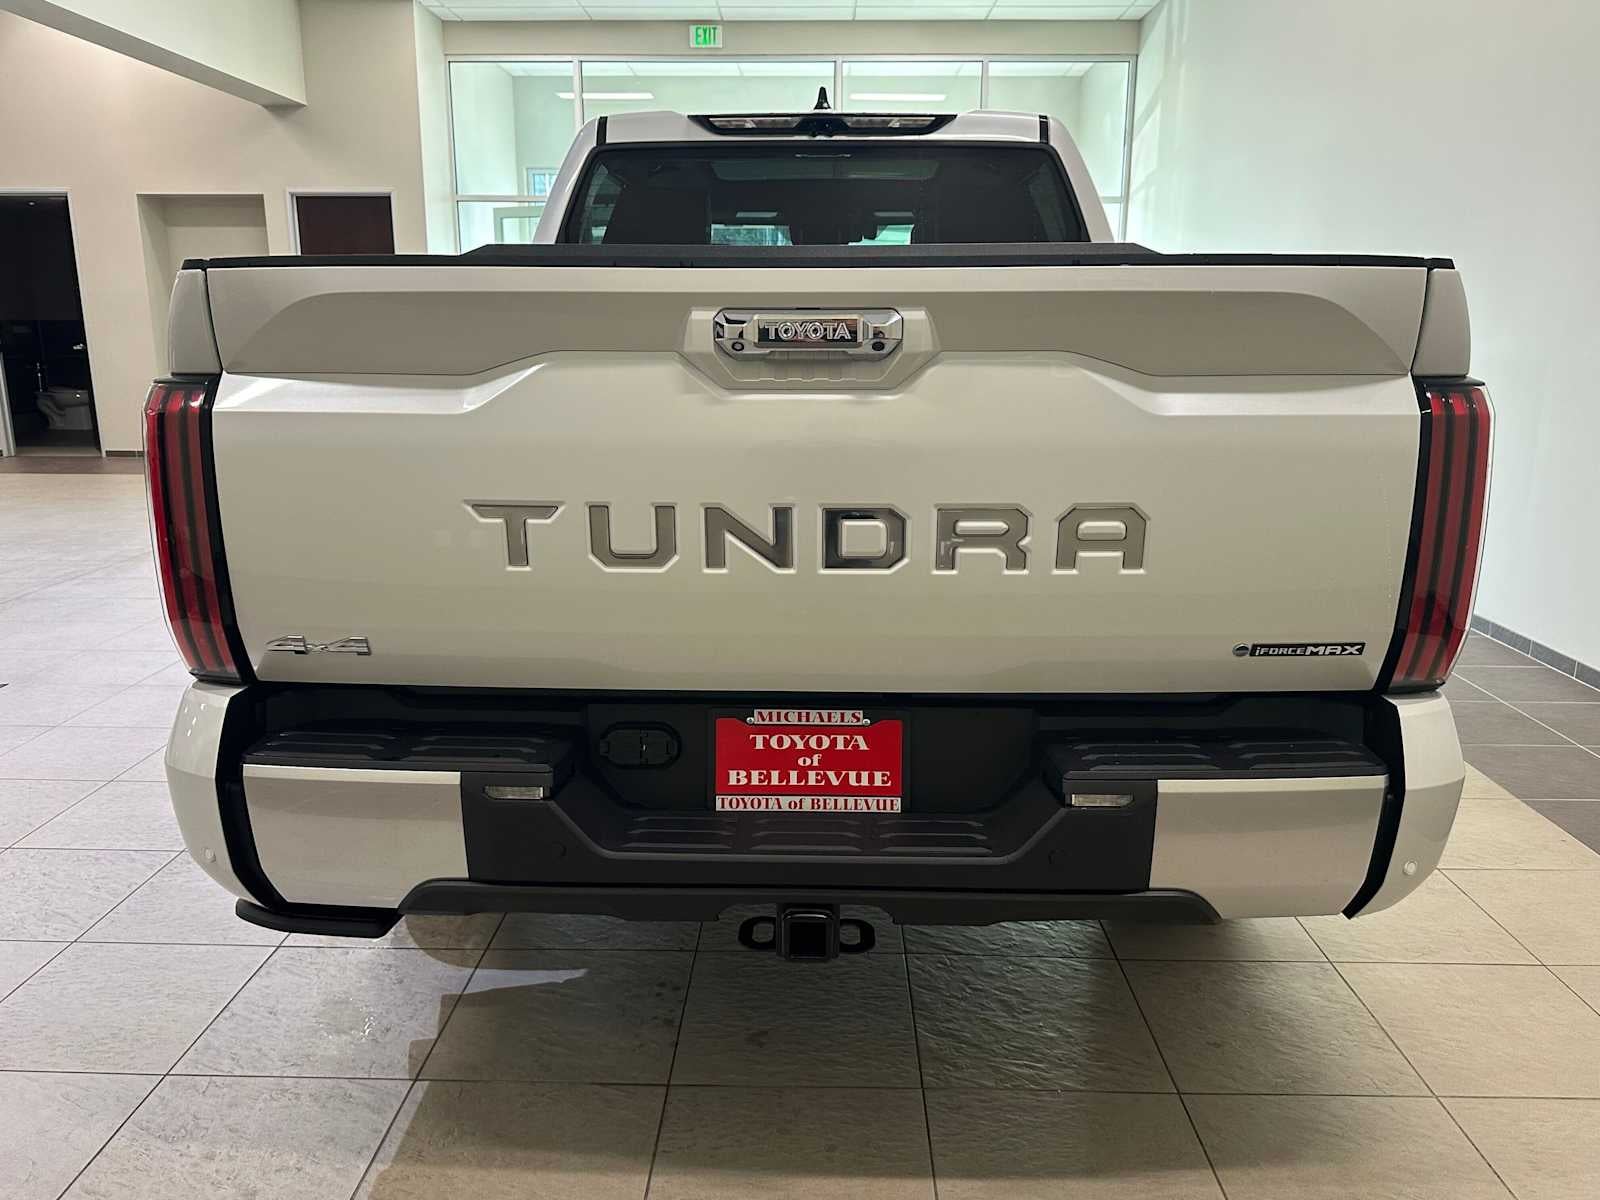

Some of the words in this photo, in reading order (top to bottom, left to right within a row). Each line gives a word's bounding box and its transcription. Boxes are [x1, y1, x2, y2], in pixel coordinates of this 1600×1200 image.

[695, 26, 718, 46] EXIT
[765, 321, 852, 340] TOYOTA
[464, 501, 1150, 575] TUNDRA
[756, 710, 862, 724] MICHAELS
[749, 734, 870, 750] TOYOTA
[797, 753, 823, 767] of
[727, 769, 892, 787] BELLEVUE
[717, 797, 782, 810] TOYOTA
[788, 797, 805, 810] of
[809, 797, 900, 811] BELLEVUE
